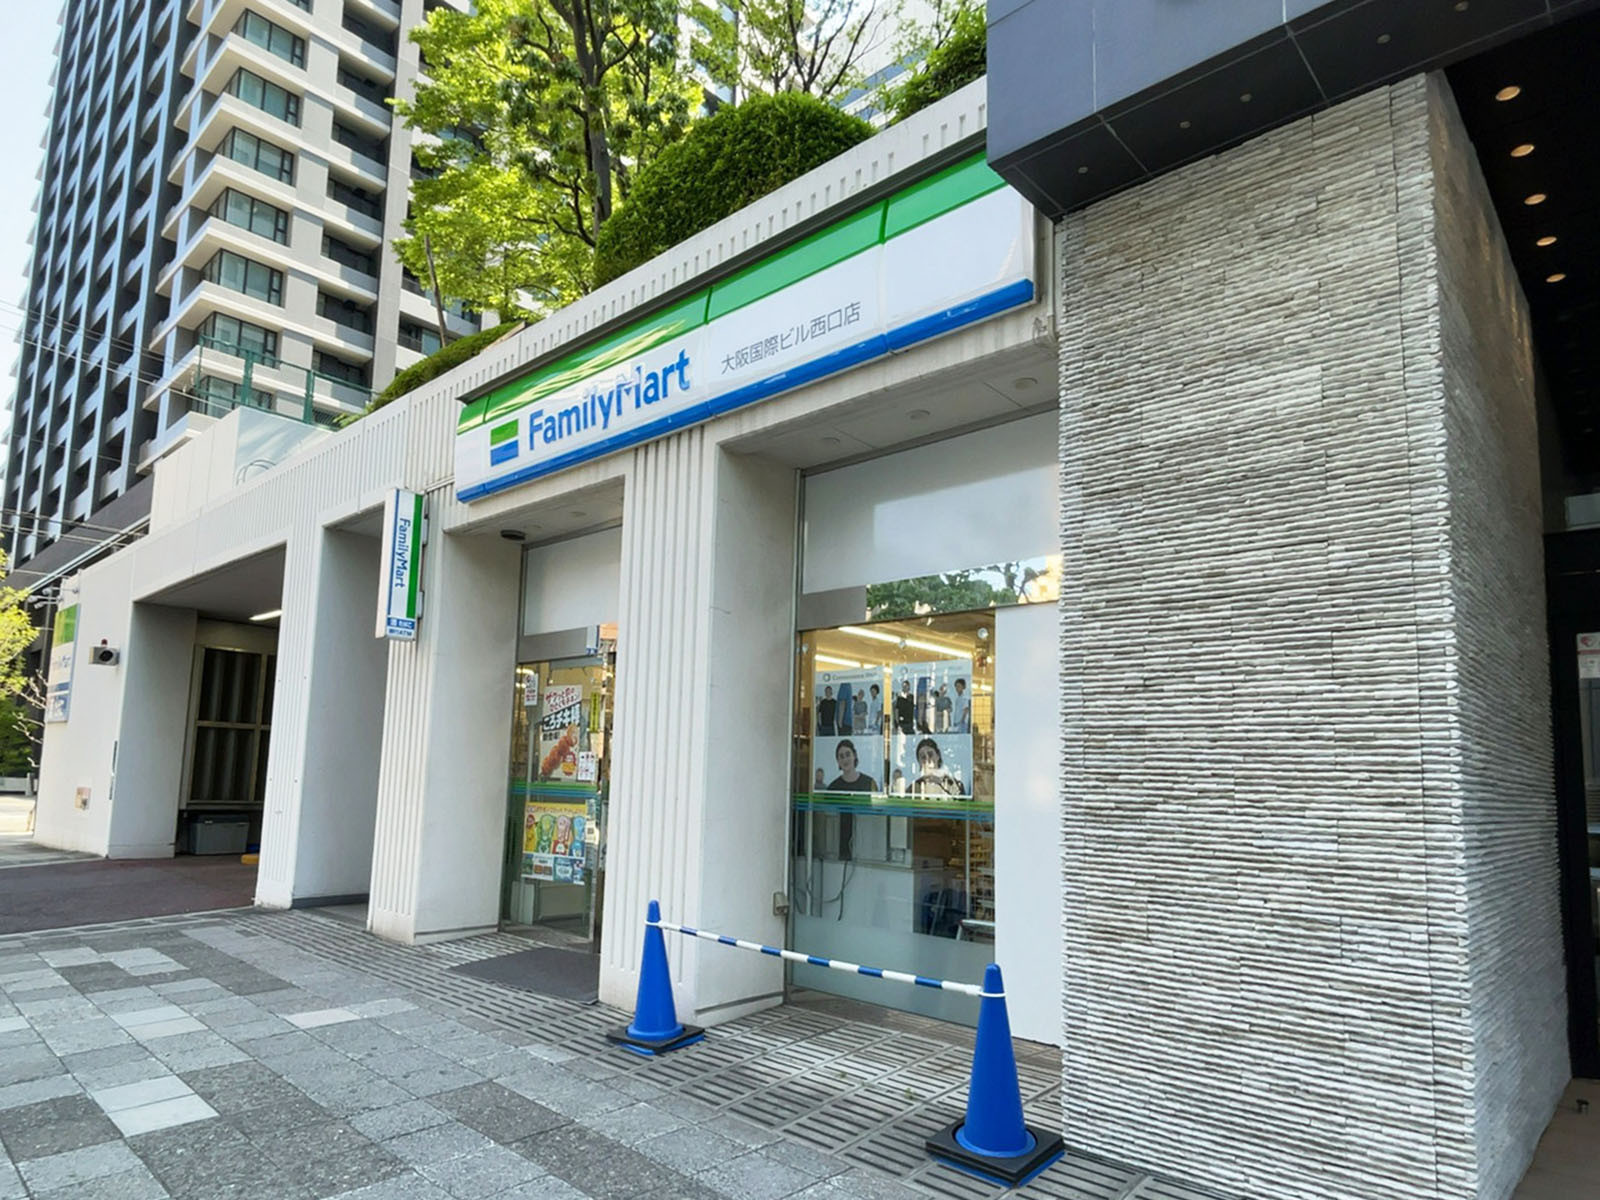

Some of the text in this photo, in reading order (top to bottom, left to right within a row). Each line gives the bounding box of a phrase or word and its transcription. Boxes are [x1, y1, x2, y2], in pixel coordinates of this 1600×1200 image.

[721, 301, 861, 375] 大阪国際ビル西口店
[529, 348, 690, 450] FamilyMart
[395, 518, 411, 589] FamilyMart
